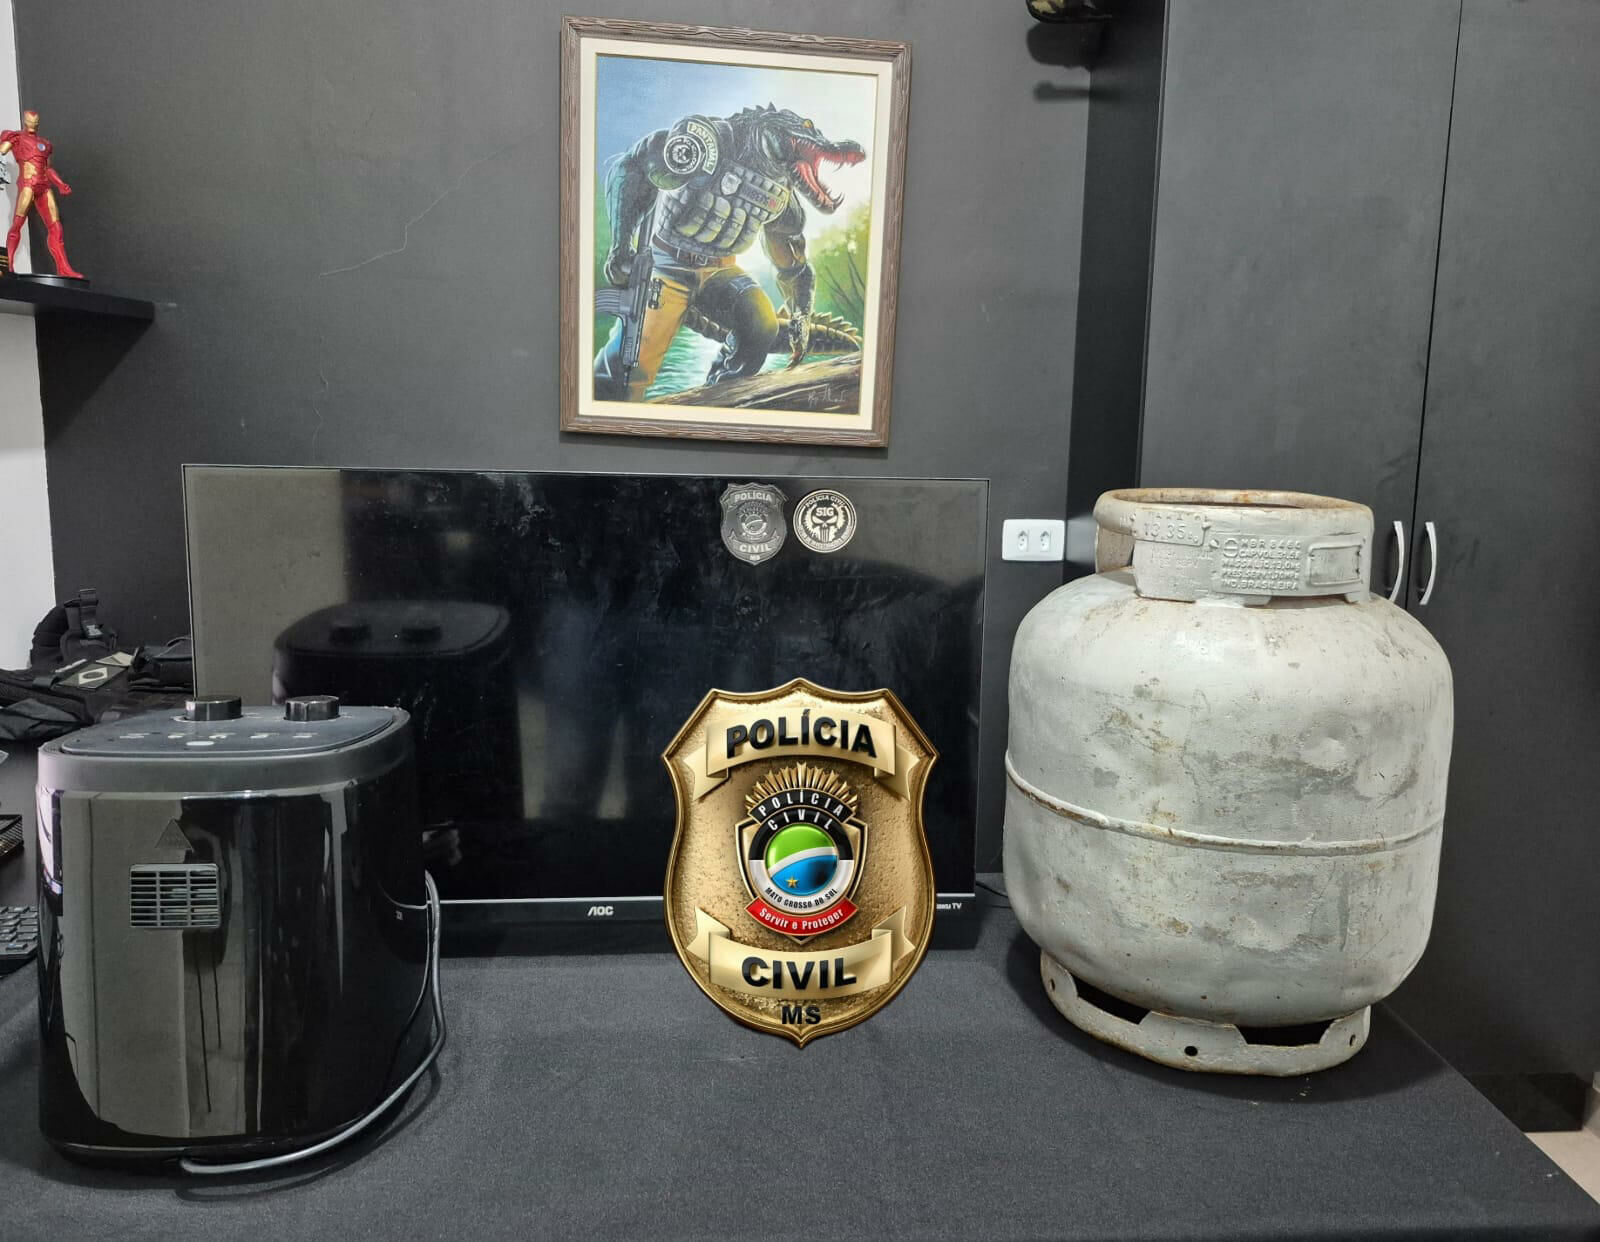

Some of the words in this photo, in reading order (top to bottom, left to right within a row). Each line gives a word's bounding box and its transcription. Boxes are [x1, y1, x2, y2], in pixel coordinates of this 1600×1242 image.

[815, 506, 834, 517] SIG
[739, 543, 773, 554] CIVIL
[587, 905, 614, 917] AOC
[951, 902, 962, 910] TV
